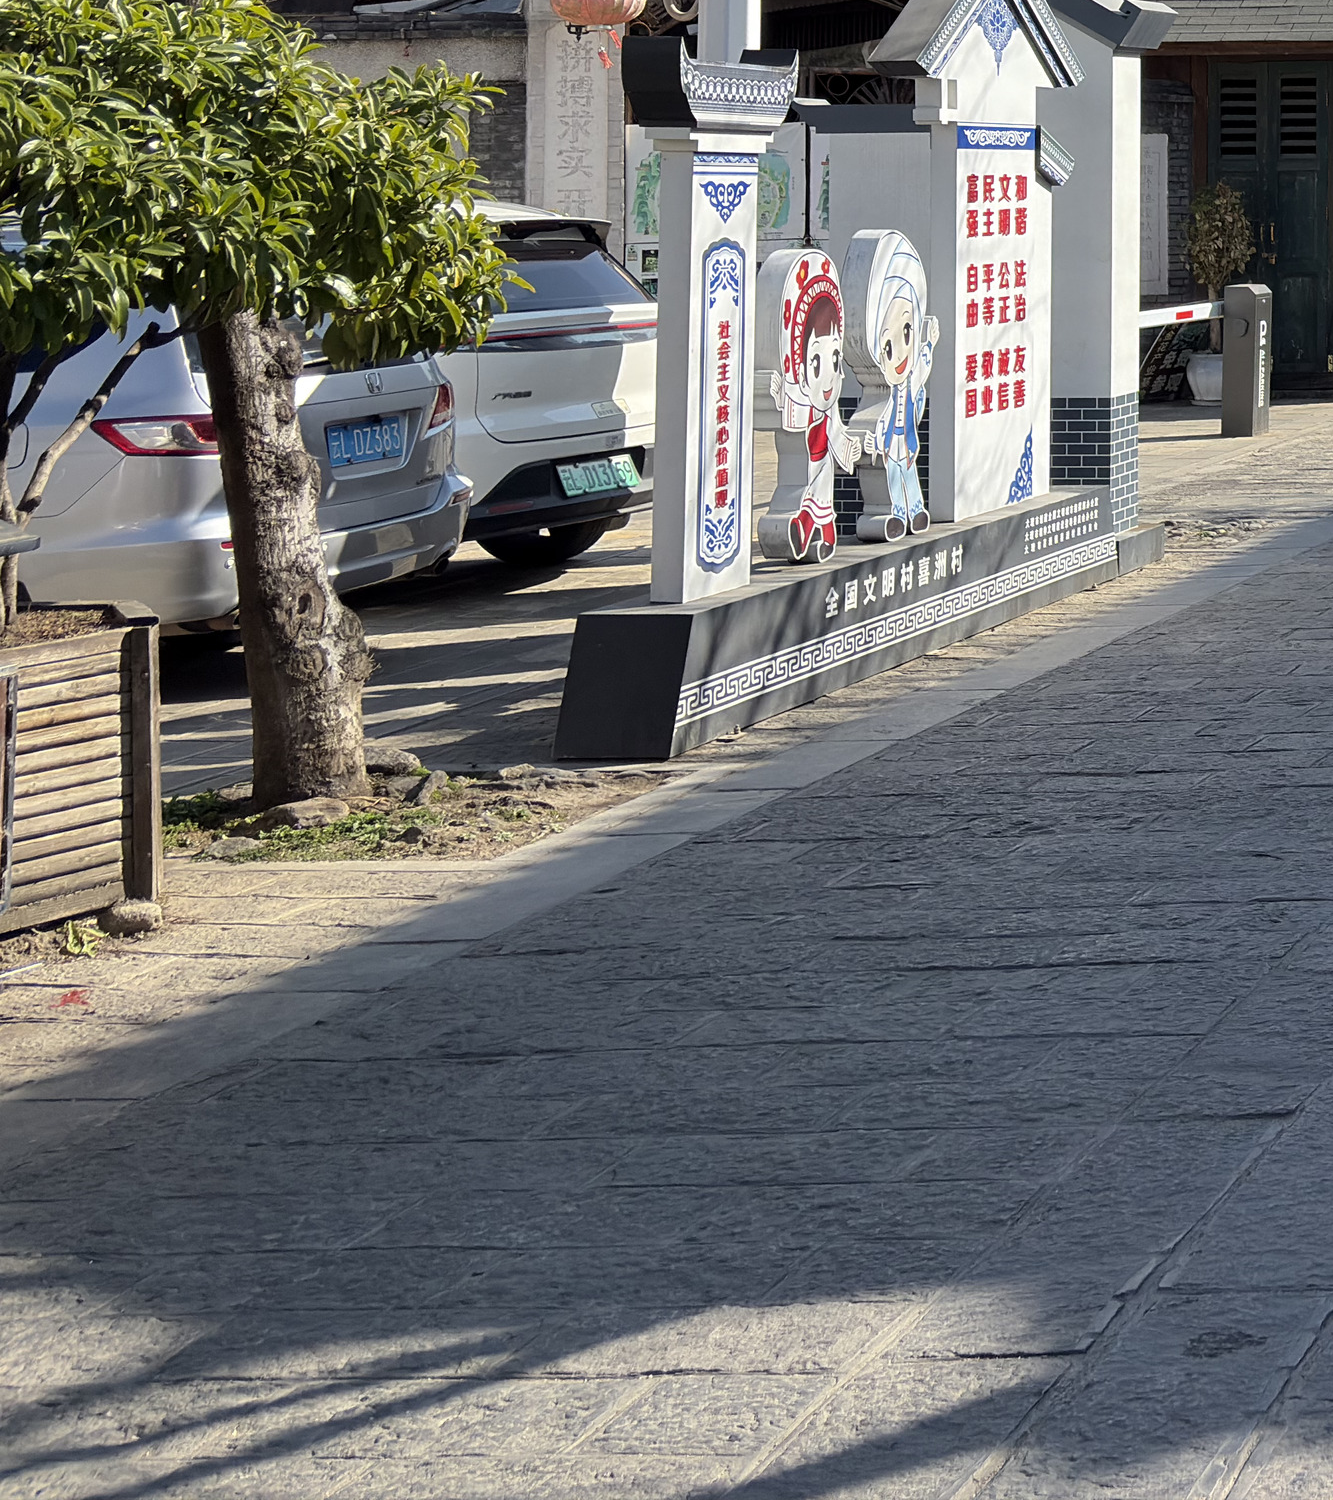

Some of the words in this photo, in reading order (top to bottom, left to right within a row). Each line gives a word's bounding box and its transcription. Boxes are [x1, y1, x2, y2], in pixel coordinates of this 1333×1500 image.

[714, 320, 732, 509] 社会主义核心价值观
[825, 543, 964, 619] 全国文明村喜洲村
